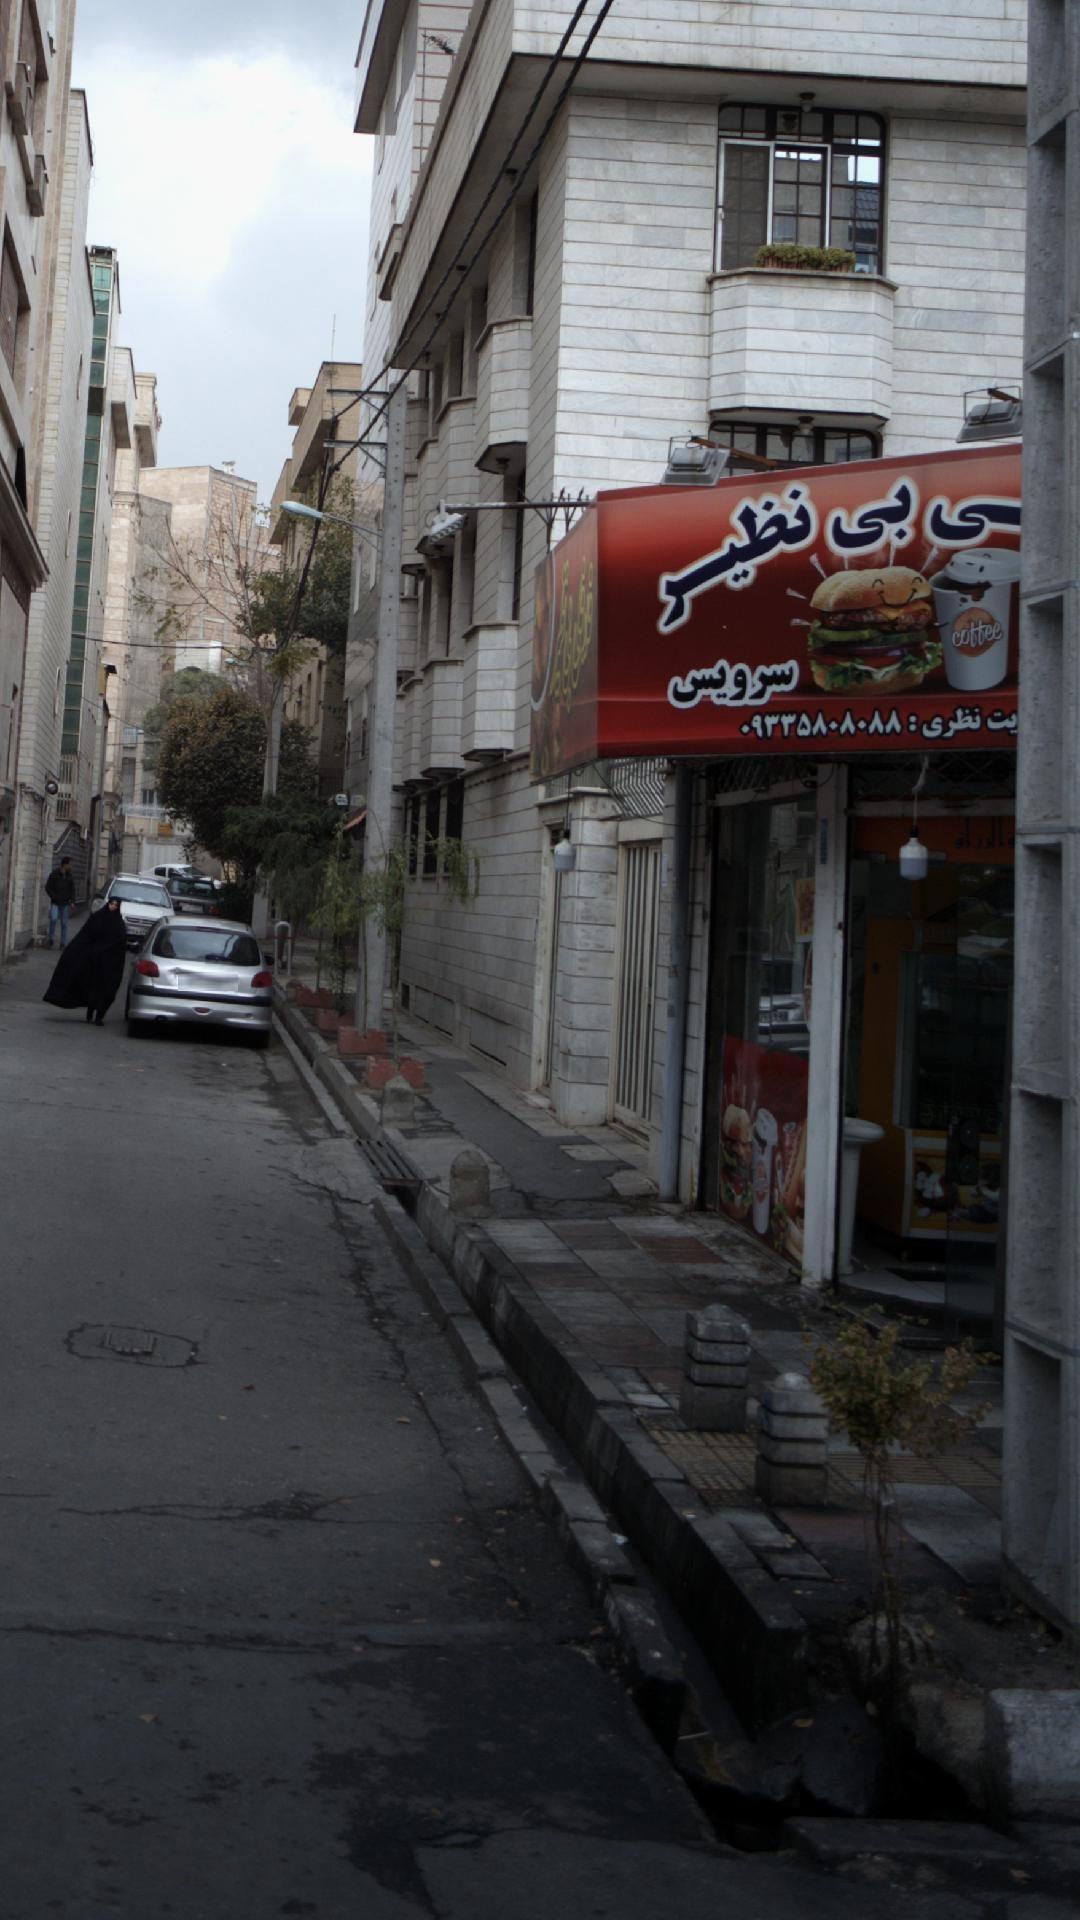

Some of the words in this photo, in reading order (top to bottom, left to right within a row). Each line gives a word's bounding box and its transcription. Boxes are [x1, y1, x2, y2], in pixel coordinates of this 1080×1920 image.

[826, 475, 920, 554] بی
[657, 479, 818, 635] نظیر
[952, 620, 1003, 648] coffee
[669, 658, 800, 708] سرویس
